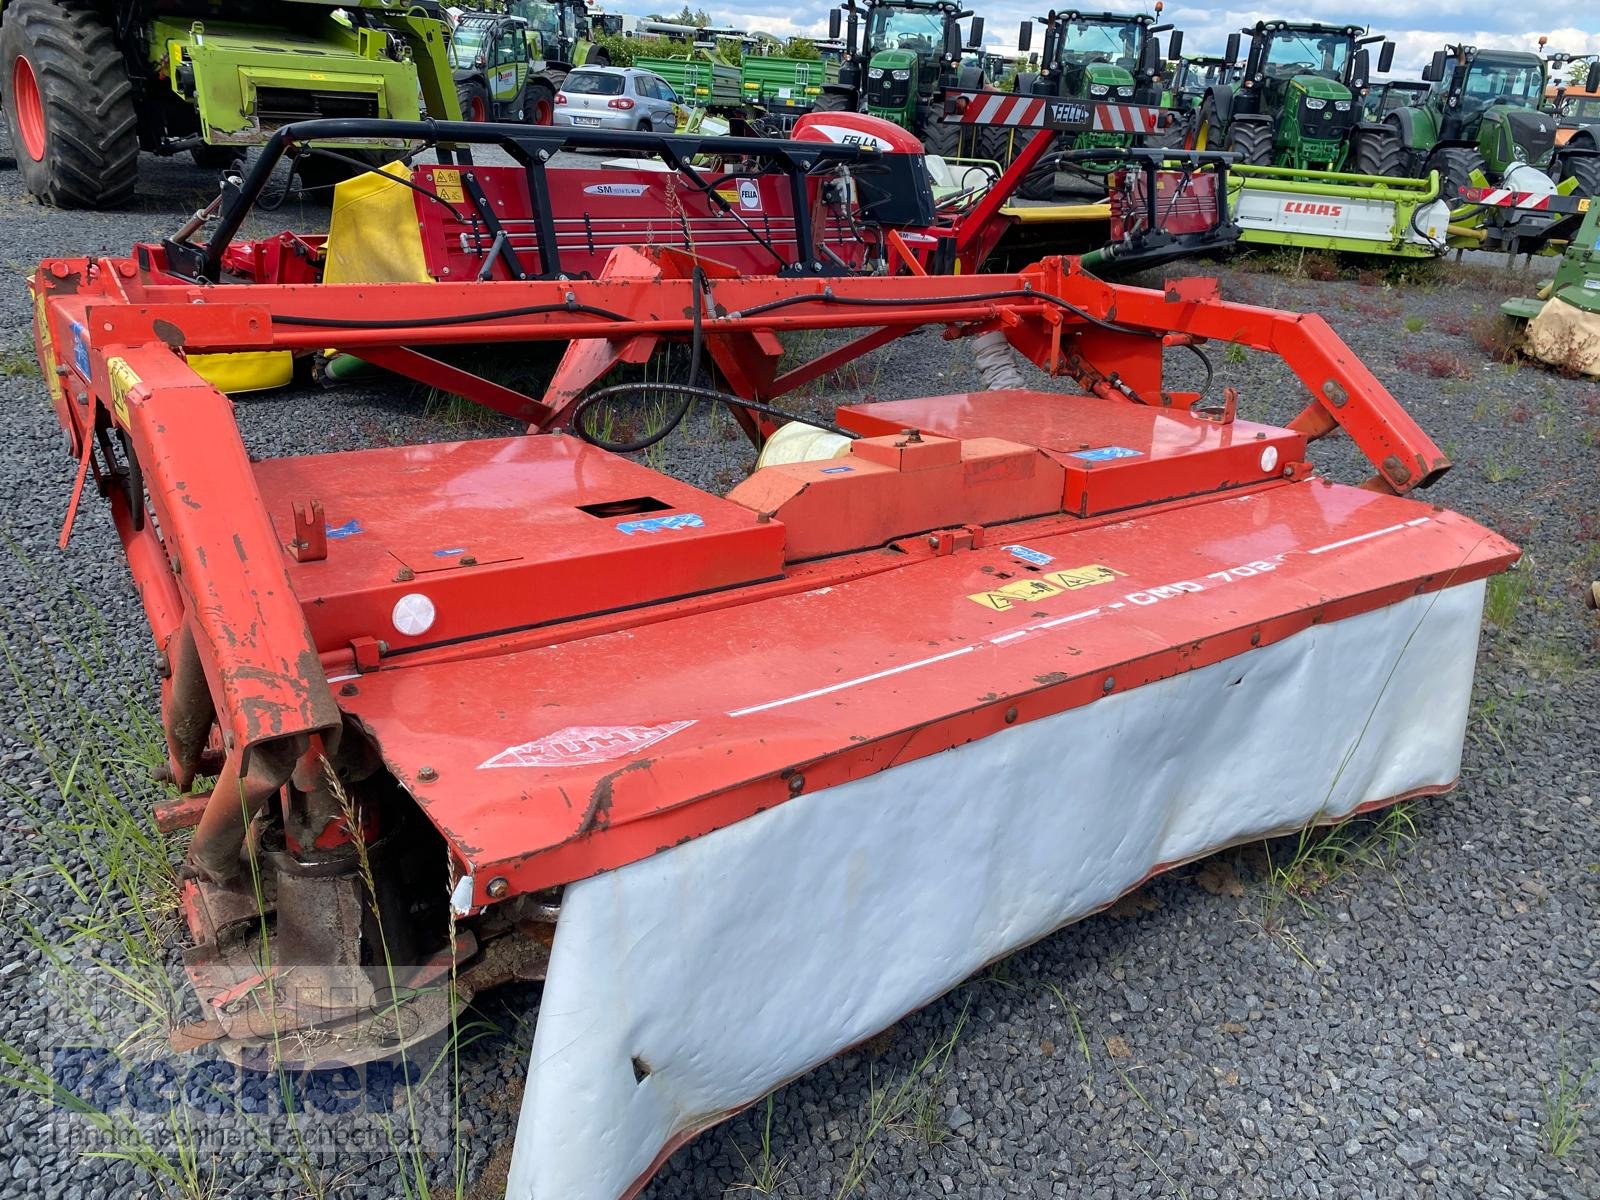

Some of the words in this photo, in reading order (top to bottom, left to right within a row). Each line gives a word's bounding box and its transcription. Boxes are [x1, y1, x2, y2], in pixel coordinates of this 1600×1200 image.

[1053, 103, 1087, 124] FELLA
[842, 134, 877, 147] FELLA
[597, 186, 613, 194] SM
[741, 190, 757, 198] FELLA
[1284, 202, 1343, 217] CLAAS
[1207, 560, 1276, 582] 702
